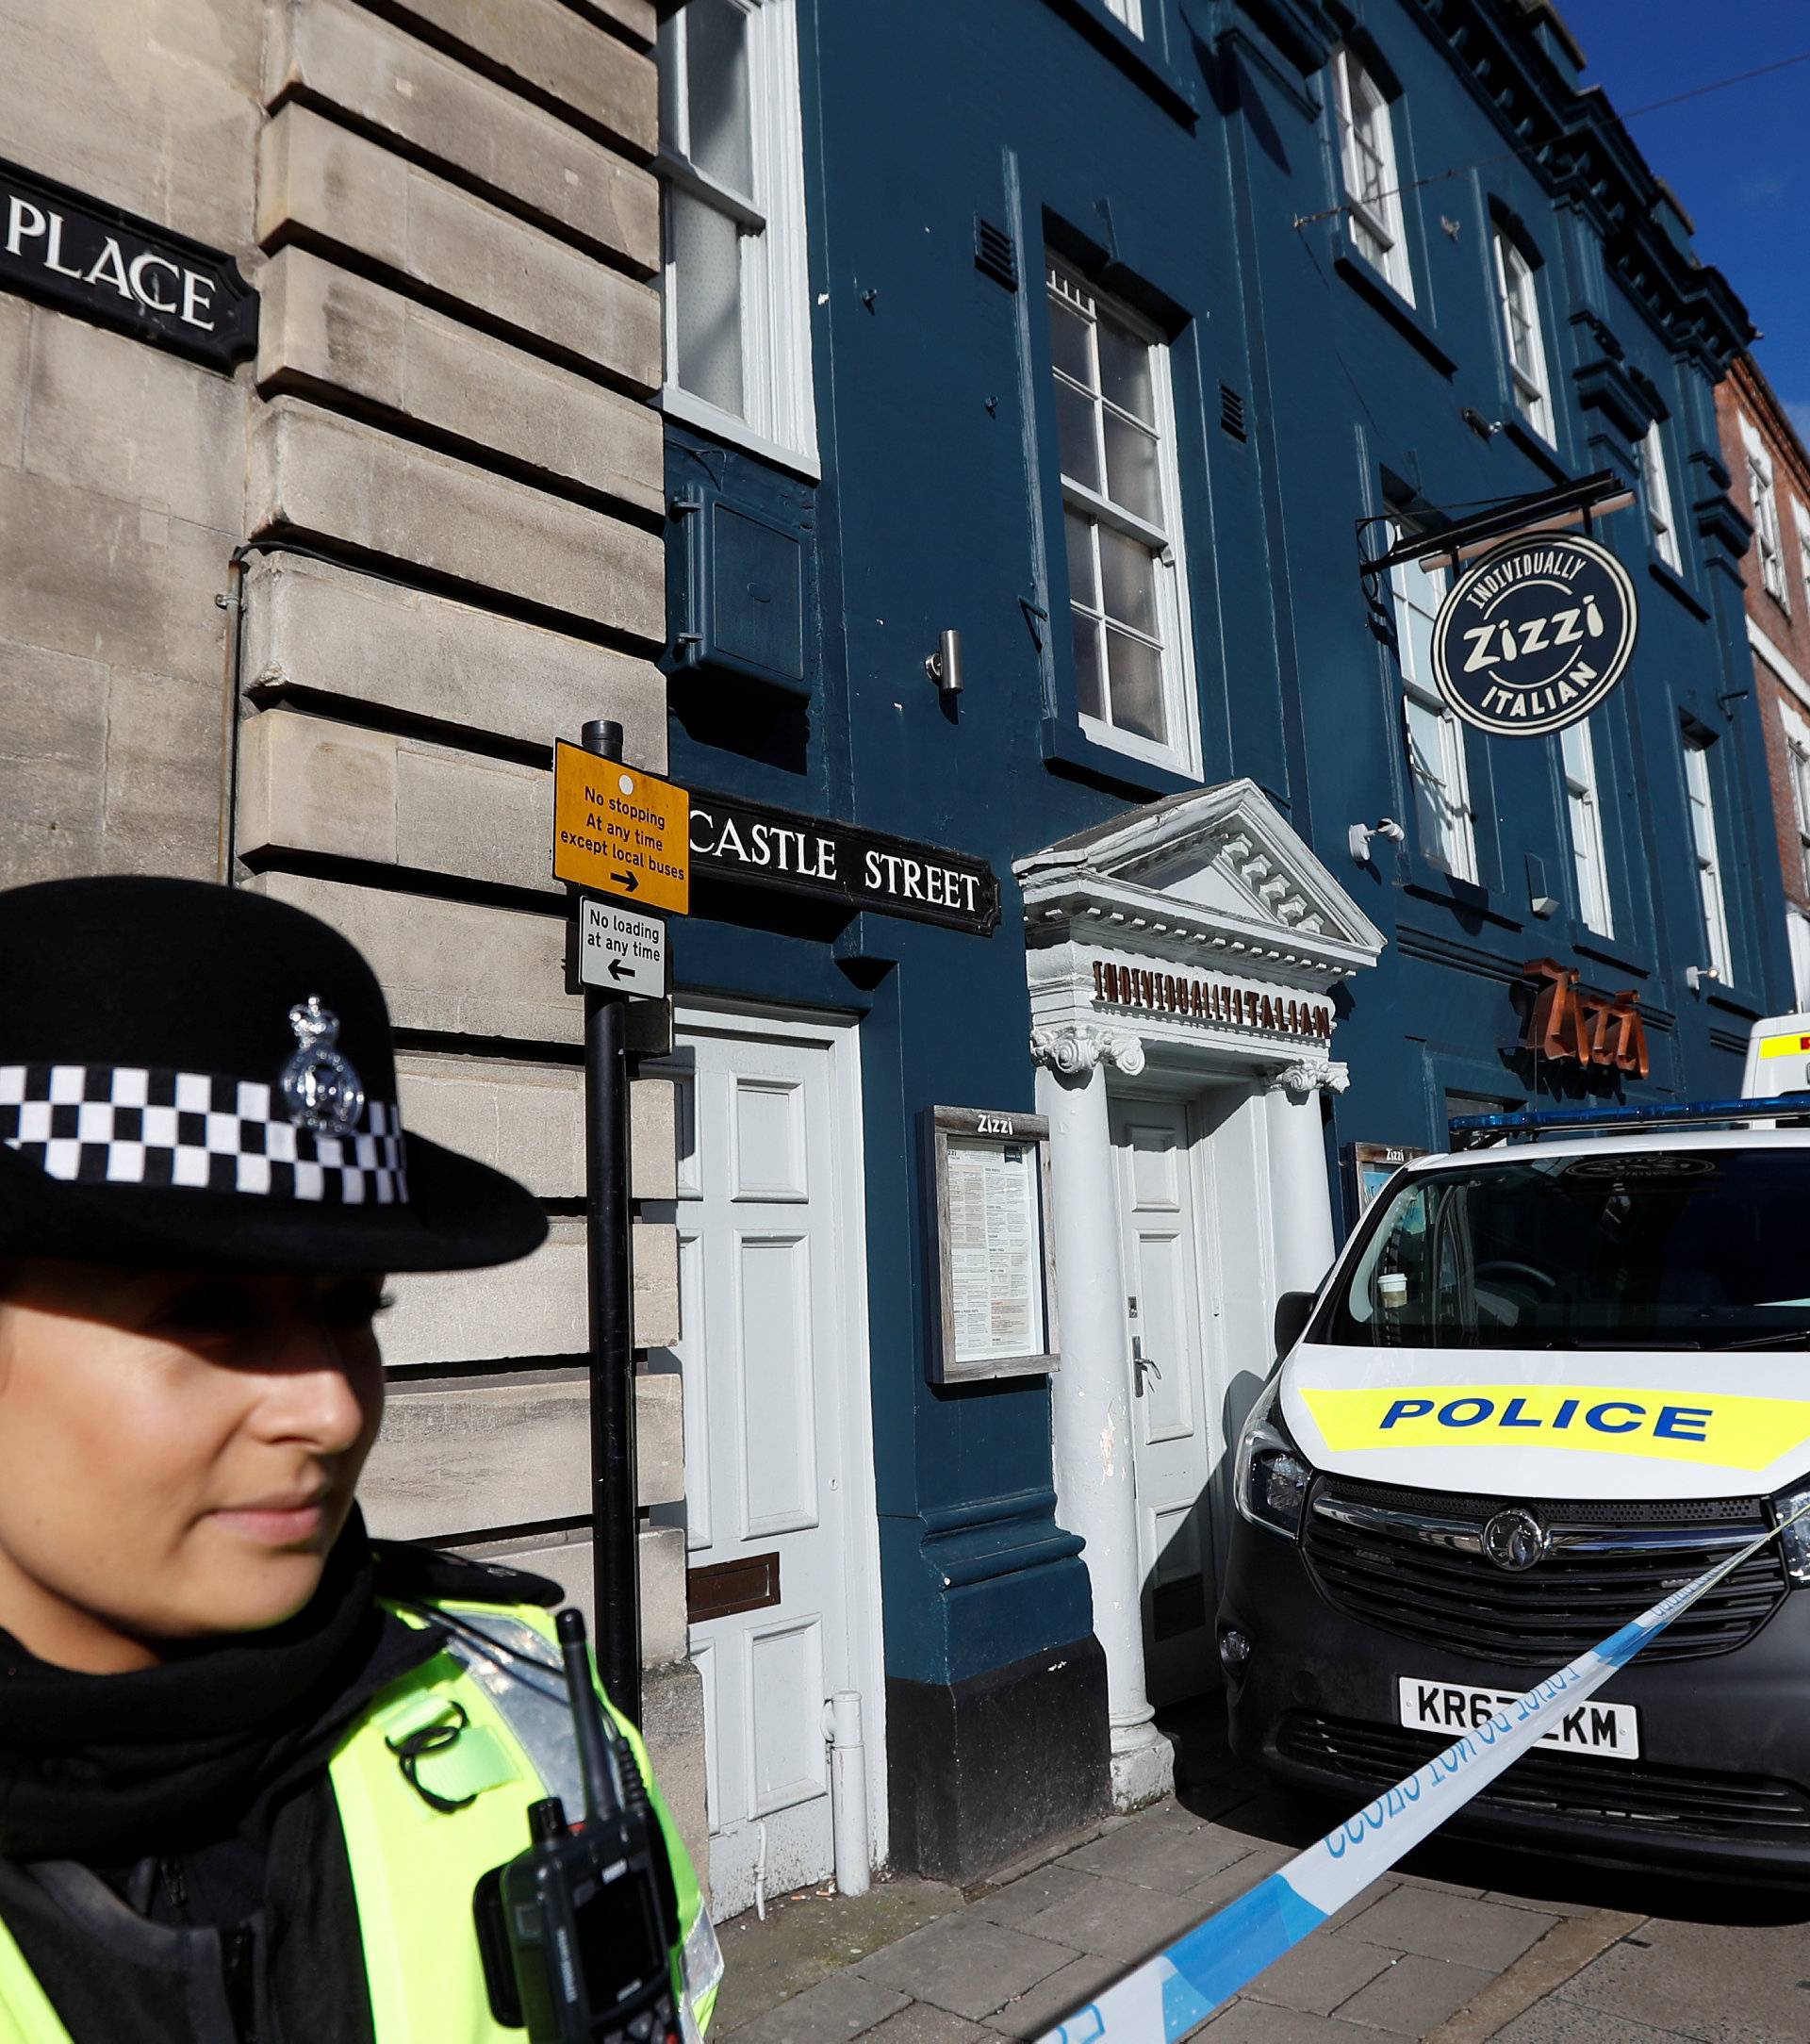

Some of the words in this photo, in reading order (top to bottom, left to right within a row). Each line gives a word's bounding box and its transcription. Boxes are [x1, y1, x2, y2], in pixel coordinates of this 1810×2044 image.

[5, 194, 216, 331] PLACE
[1466, 551, 1587, 610] INDIVIDUALLY
[1463, 594, 1604, 673] Zizzi
[1481, 661, 1598, 717] ITALIAN
[584, 785, 604, 806] No
[608, 798, 665, 831] stopping
[586, 813, 602, 832] At
[607, 822, 631, 842] any
[634, 829, 664, 851] time
[560, 831, 608, 856] except
[612, 844, 644, 867] local
[649, 855, 684, 881] buses
[689, 809, 837, 881] CASTLE
[864, 849, 980, 912] STREET
[587, 931, 601, 948] at
[605, 937, 629, 956] any
[633, 941, 661, 962] time
[590, 909, 609, 929] No
[613, 915, 659, 944] loading
[977, 1113, 1013, 1135] Zizzi
[1378, 1397, 1714, 1442] POLICE
[1540, 1706, 1618, 1748] KM
